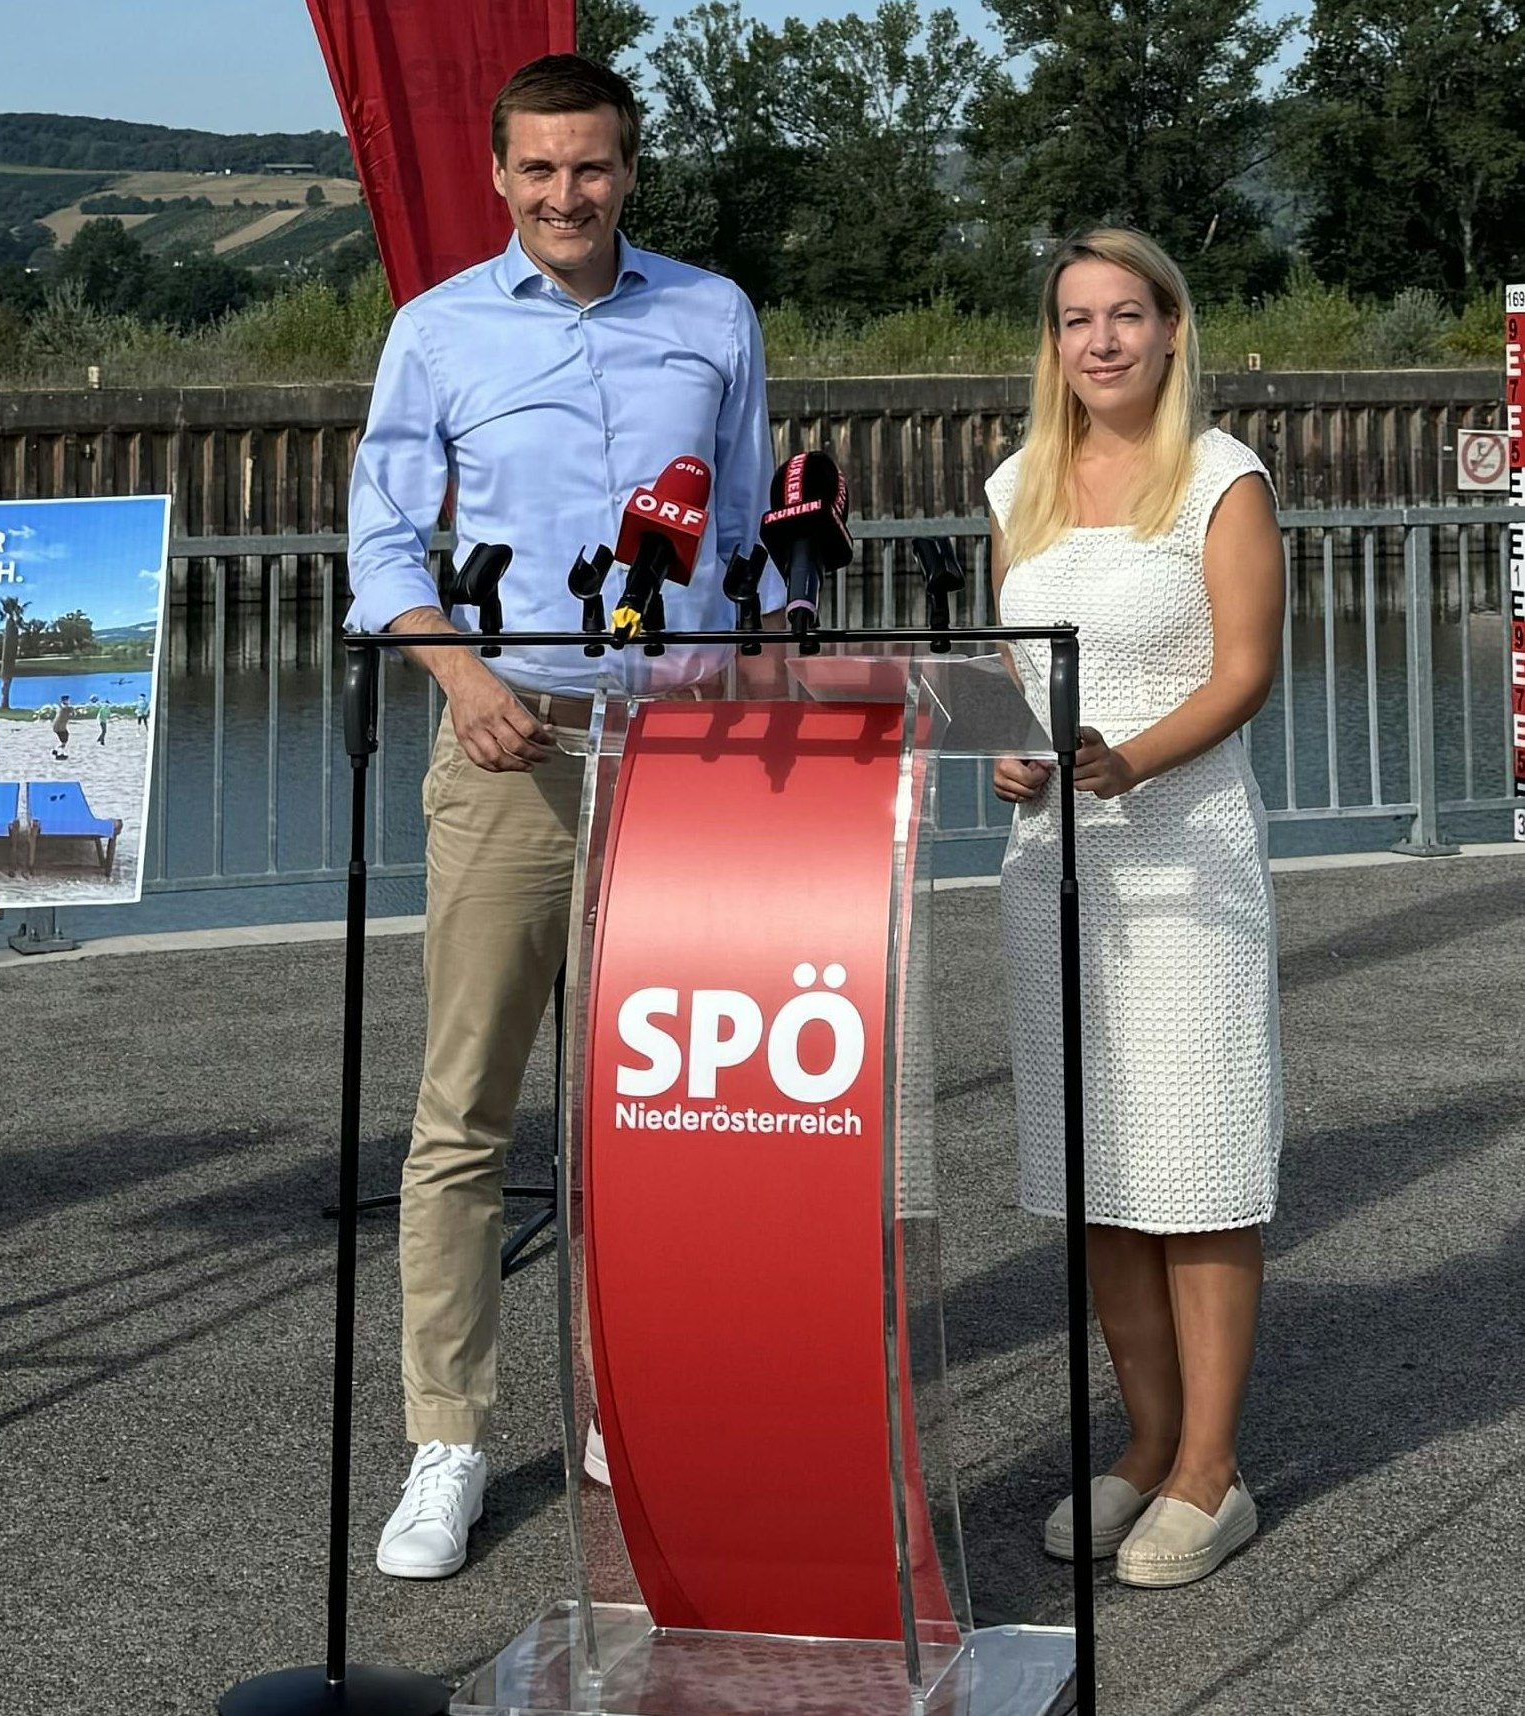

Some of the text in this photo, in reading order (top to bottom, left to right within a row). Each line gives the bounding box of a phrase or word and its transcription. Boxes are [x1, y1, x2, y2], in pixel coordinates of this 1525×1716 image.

[1509, 319, 1517, 341] 9
[1509, 379, 1518, 403] 7
[1511, 440, 1520, 463] 5
[635, 494, 704, 525] ORF
[766, 501, 820, 523] KURIER
[1515, 625, 1524, 649] 9
[1516, 688, 1525, 711] 7
[616, 962, 865, 1104] SPÖ
[615, 1102, 862, 1136] Niederösterreich
